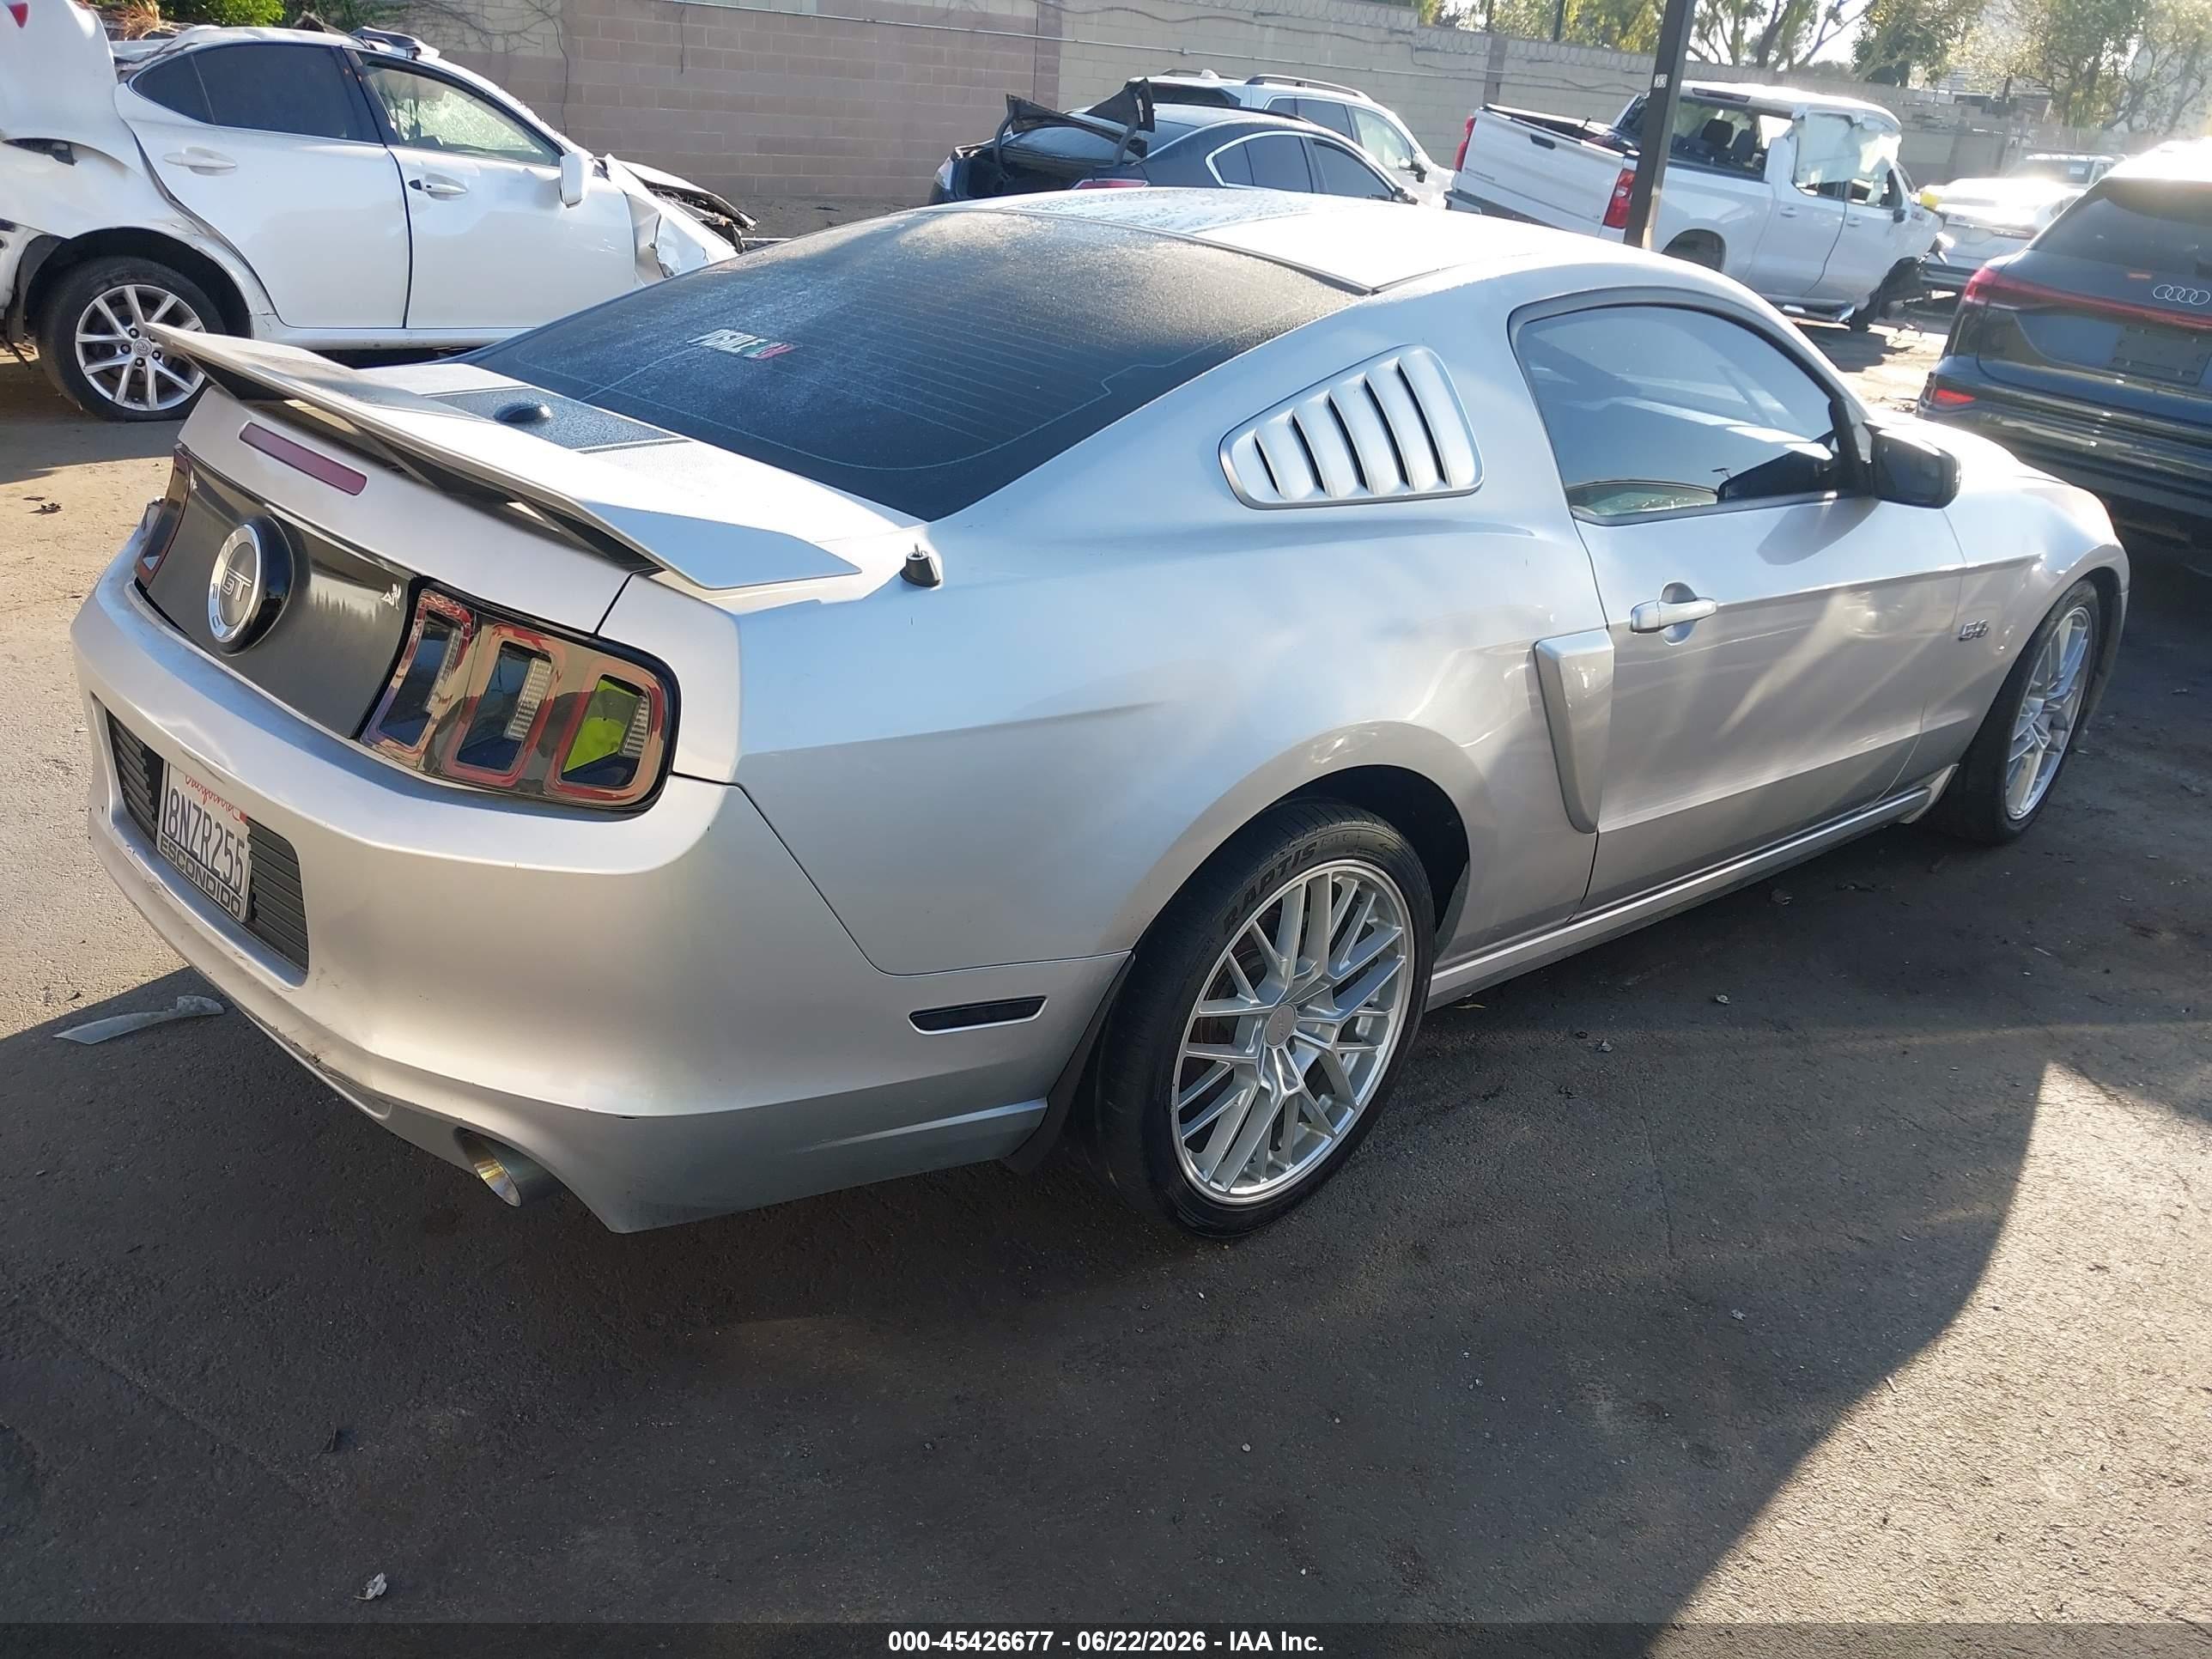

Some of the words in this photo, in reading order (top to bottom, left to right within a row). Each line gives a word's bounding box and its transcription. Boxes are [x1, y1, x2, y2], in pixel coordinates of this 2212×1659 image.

[222, 566, 252, 602] GT
[160, 836, 241, 916] ESCONDIDO
[167, 786, 246, 895] 8NZR255
